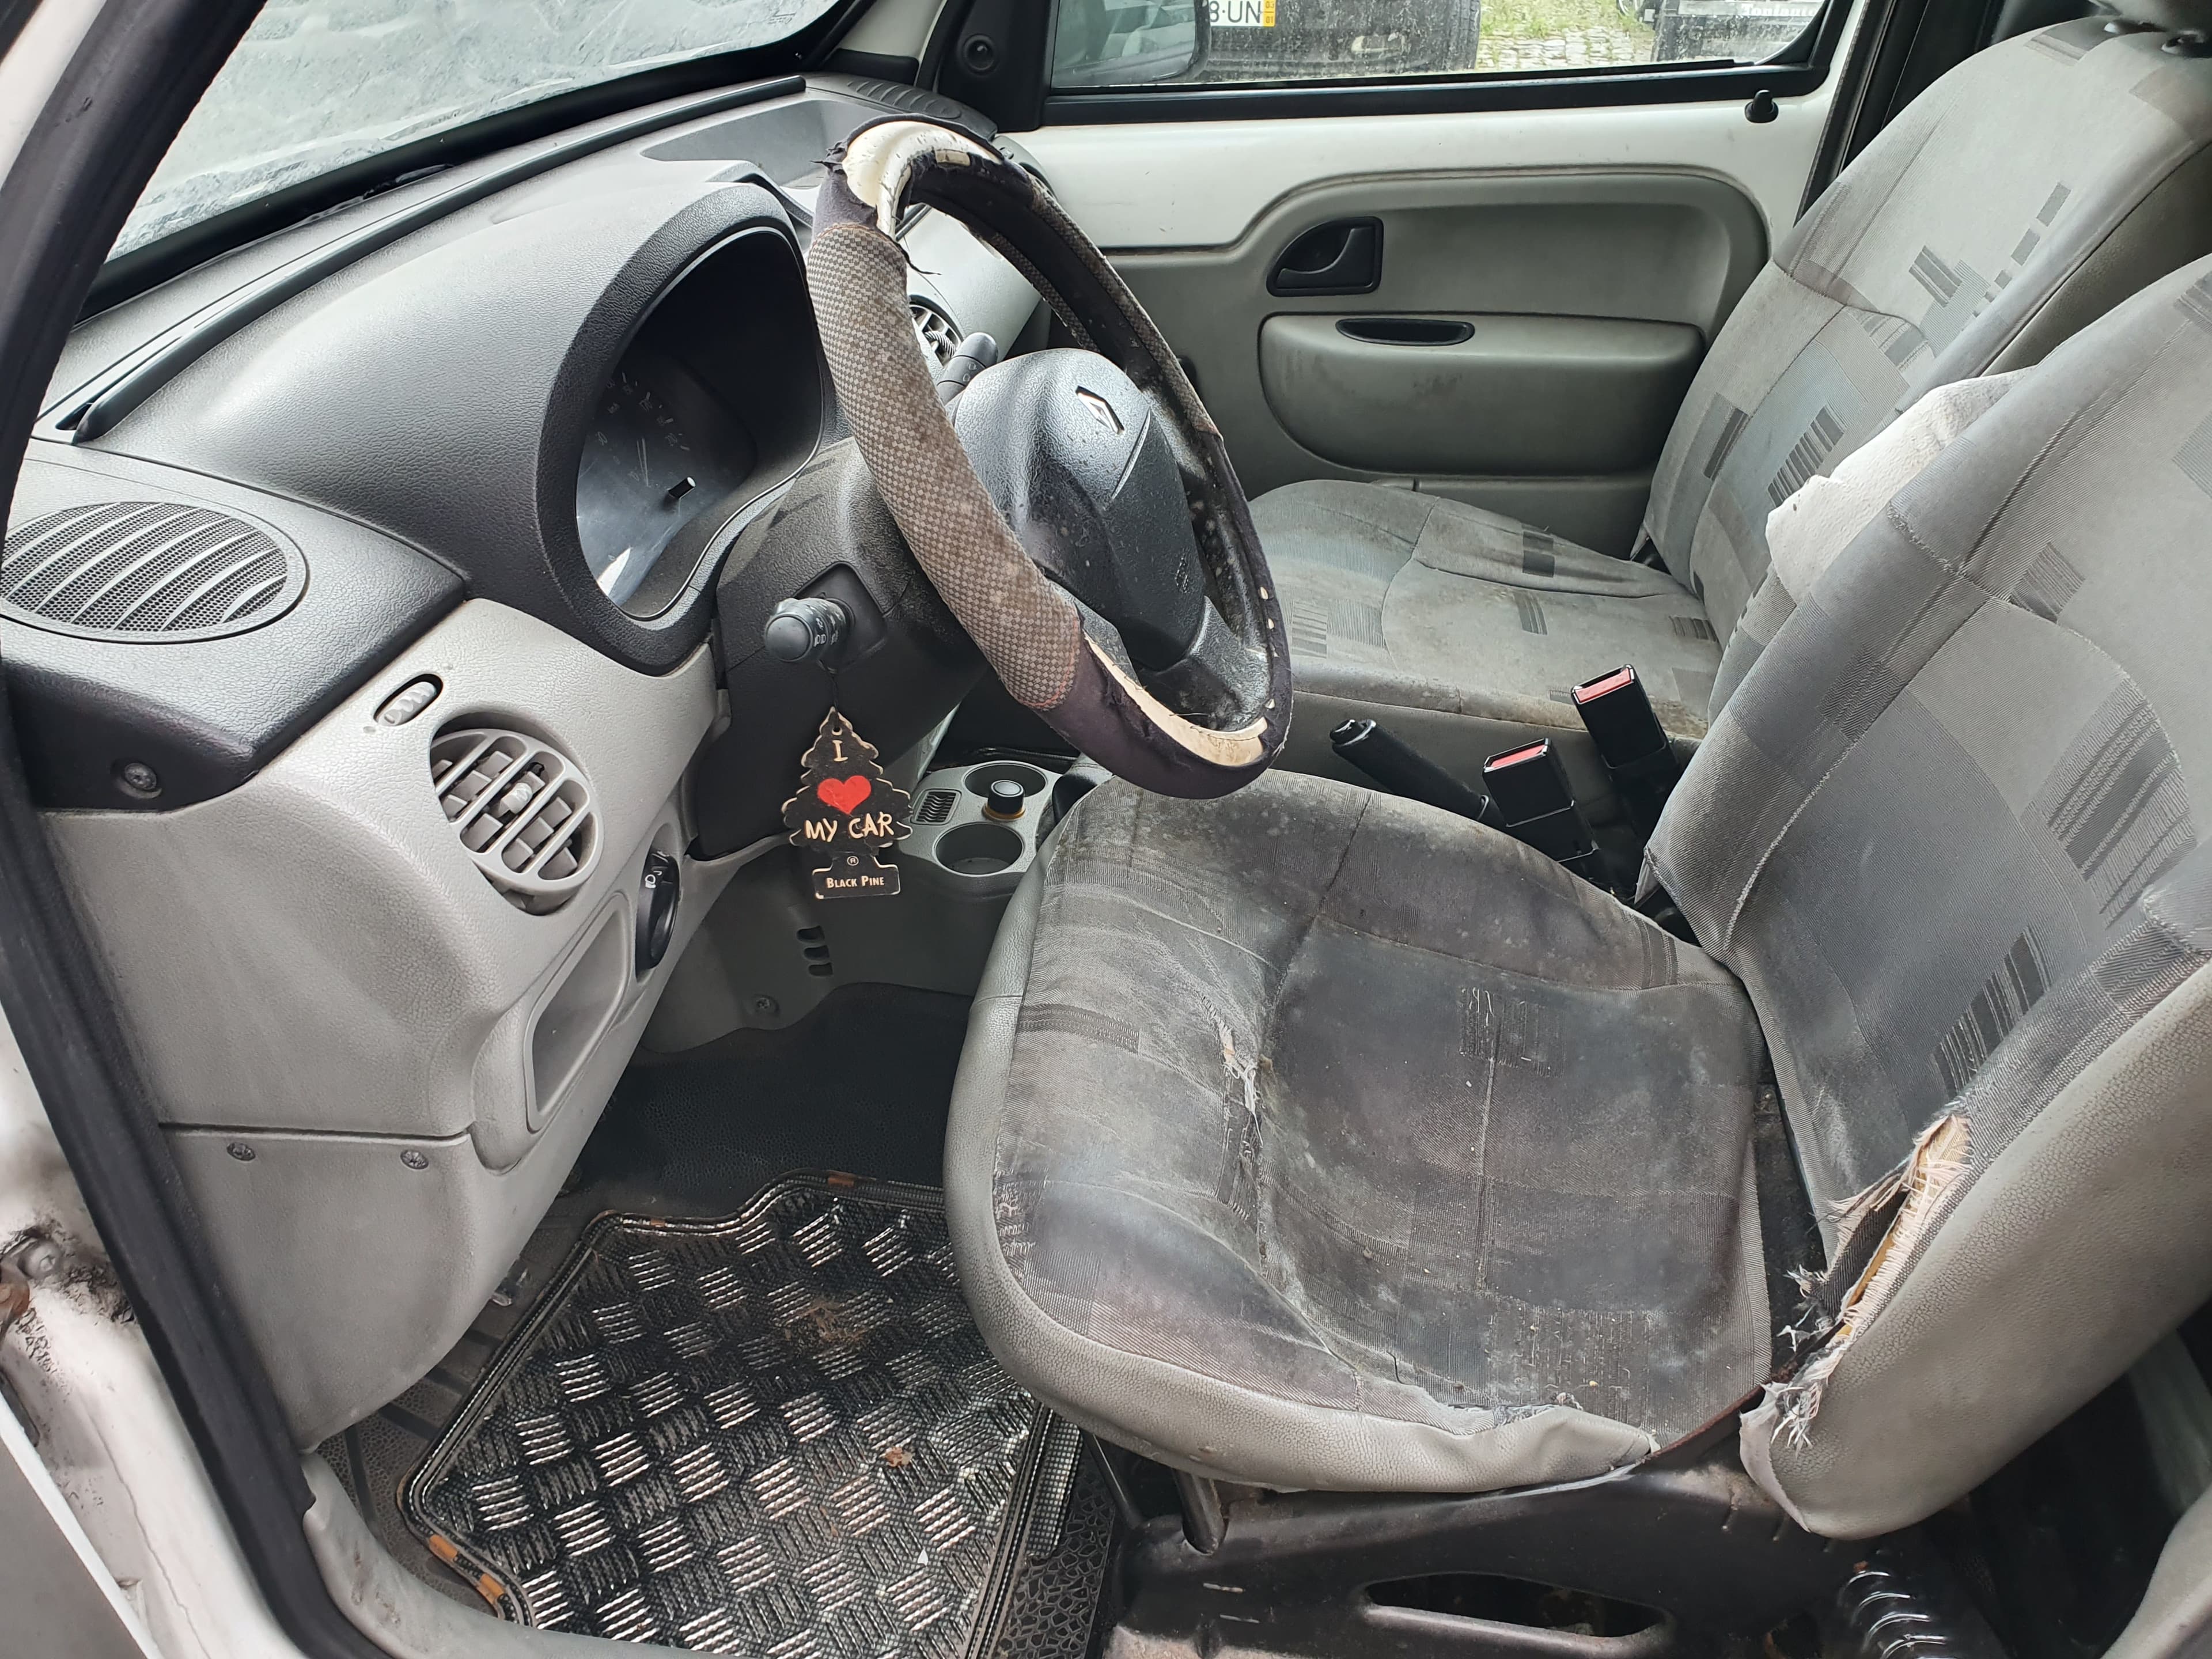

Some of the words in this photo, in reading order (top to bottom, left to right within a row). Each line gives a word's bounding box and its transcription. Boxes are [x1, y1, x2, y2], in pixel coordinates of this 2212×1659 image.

[832, 740, 848, 762] I
[805, 818, 838, 842] MY
[849, 812, 894, 839] CAR
[826, 877, 858, 888] BLACK
[861, 876, 884, 887] PINE
